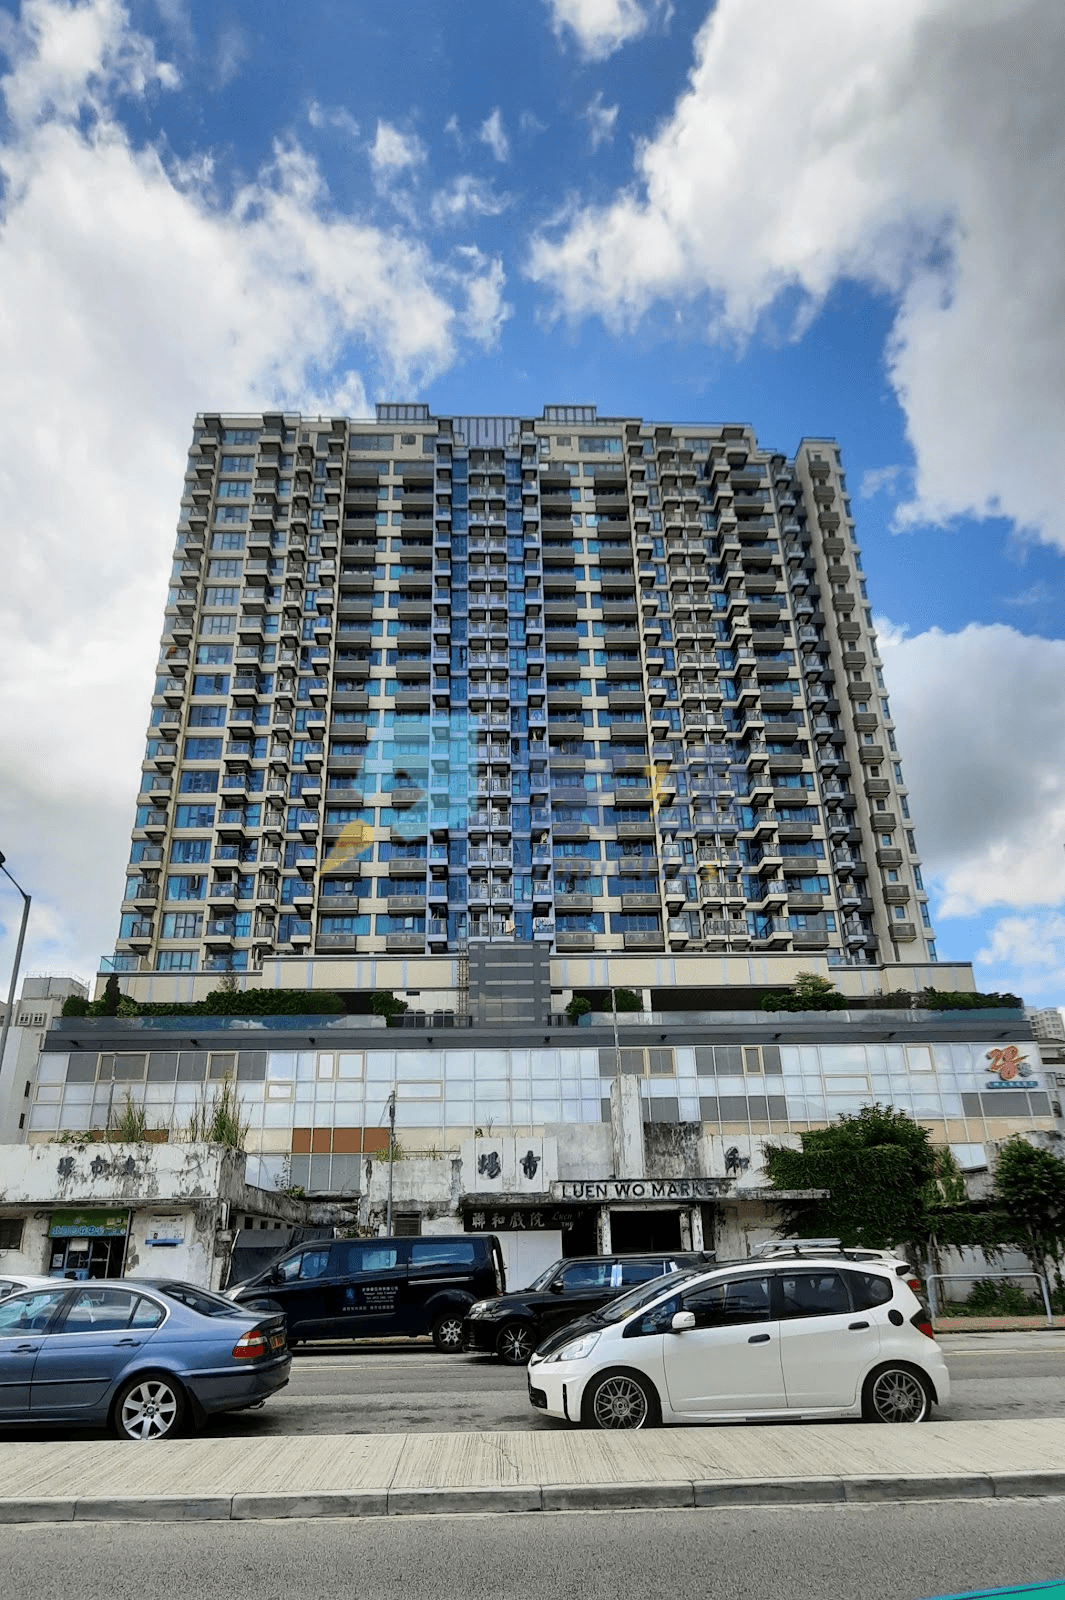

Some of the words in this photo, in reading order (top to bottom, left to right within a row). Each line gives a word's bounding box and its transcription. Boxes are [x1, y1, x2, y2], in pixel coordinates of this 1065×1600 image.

[562, 1184, 608, 1198] LUEN
[615, 1183, 645, 1197] WO
[472, 1211, 545, 1229] 聯和戲院
